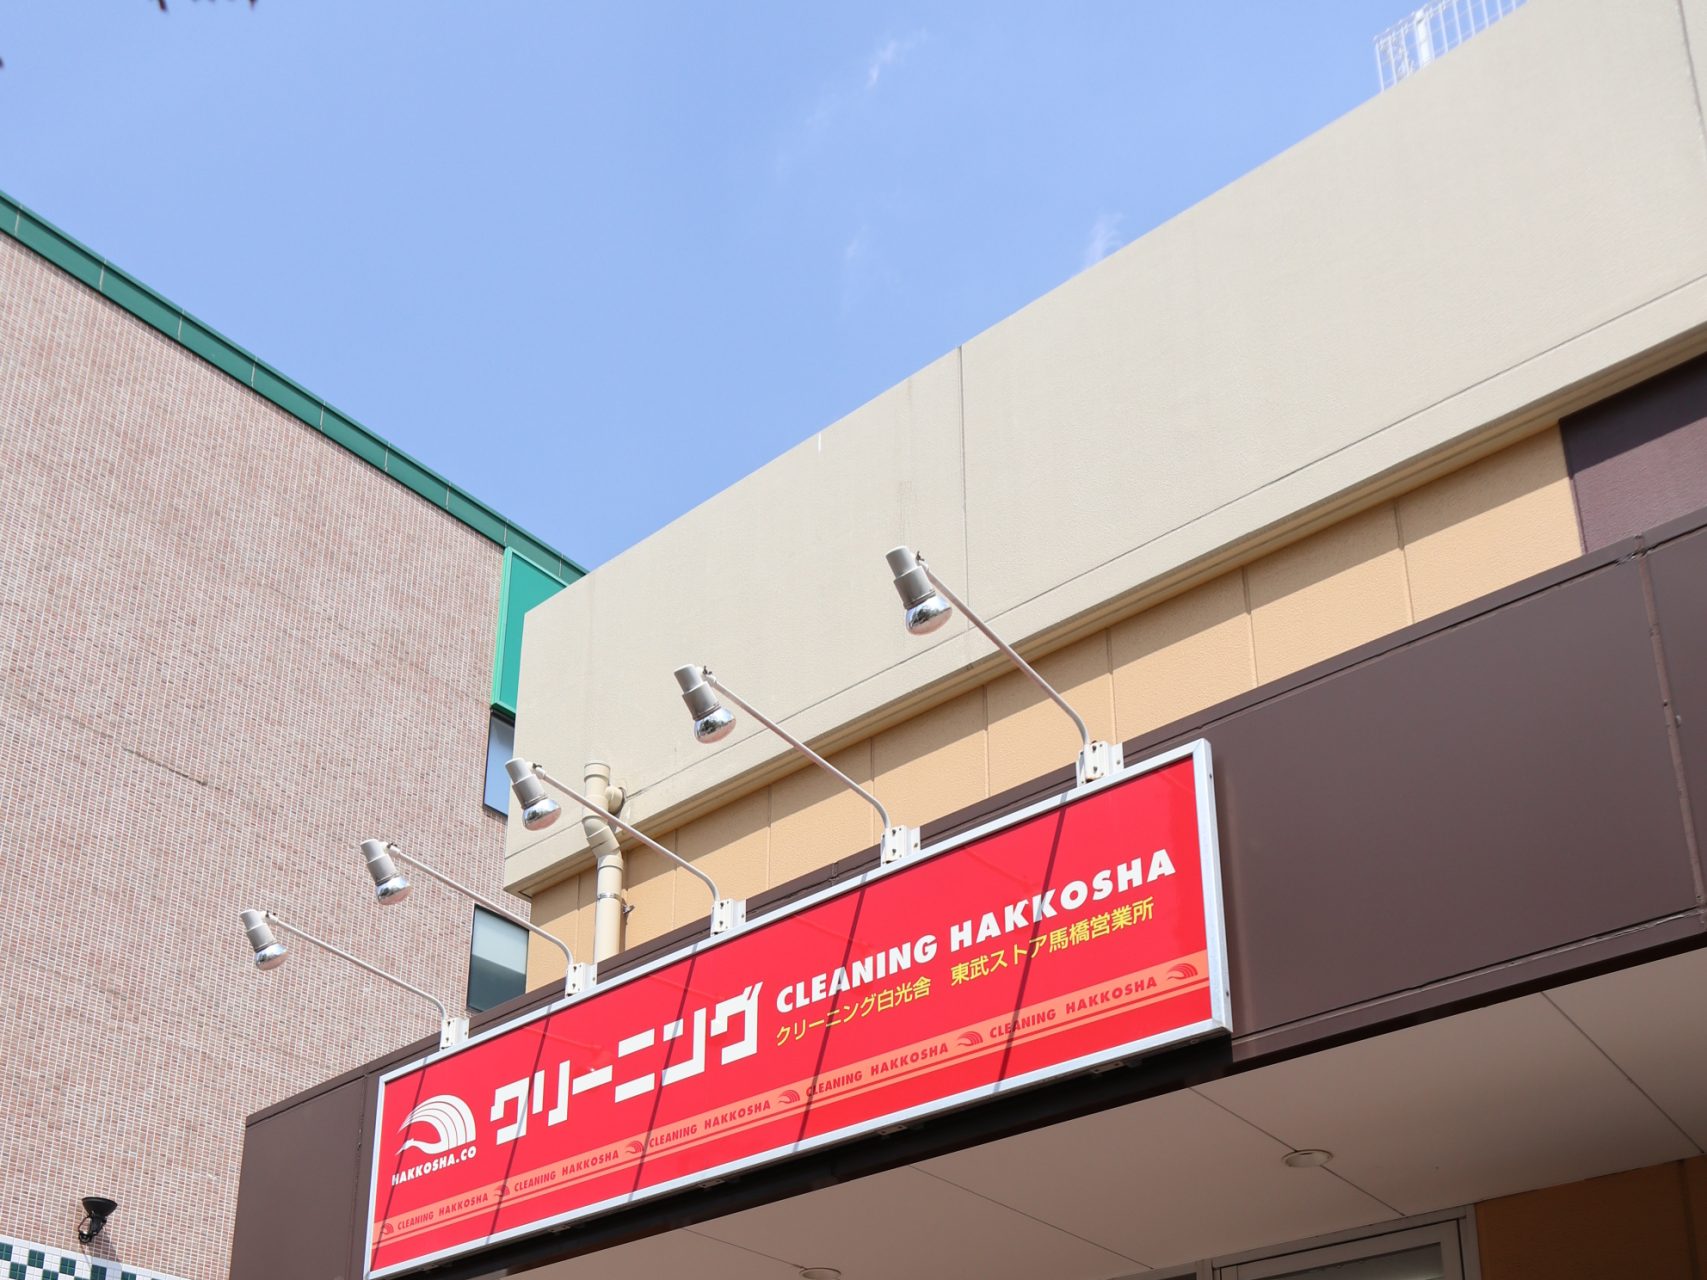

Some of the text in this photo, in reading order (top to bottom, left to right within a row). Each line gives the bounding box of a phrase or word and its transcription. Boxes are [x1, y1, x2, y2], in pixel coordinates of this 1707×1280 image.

[776, 848, 1176, 1014] CLEANING HAKKOSHA
[776, 897, 1154, 1046] クリーニング白光舎 東武ストア馬橋営業所
[989, 976, 1157, 1039] CLEANING HAKKOSHA
[490, 981, 763, 1145] クリーニング
[806, 1043, 948, 1097] CLEANING HAKKOSHA
[649, 1100, 771, 1148] CLEANING HAKKOSHA
[391, 1146, 477, 1186] HAKKOSHA.CO
[514, 1150, 619, 1192] CLEANING HAKKOSHA
[397, 1193, 488, 1230] CLEANING HAKKOSHA
